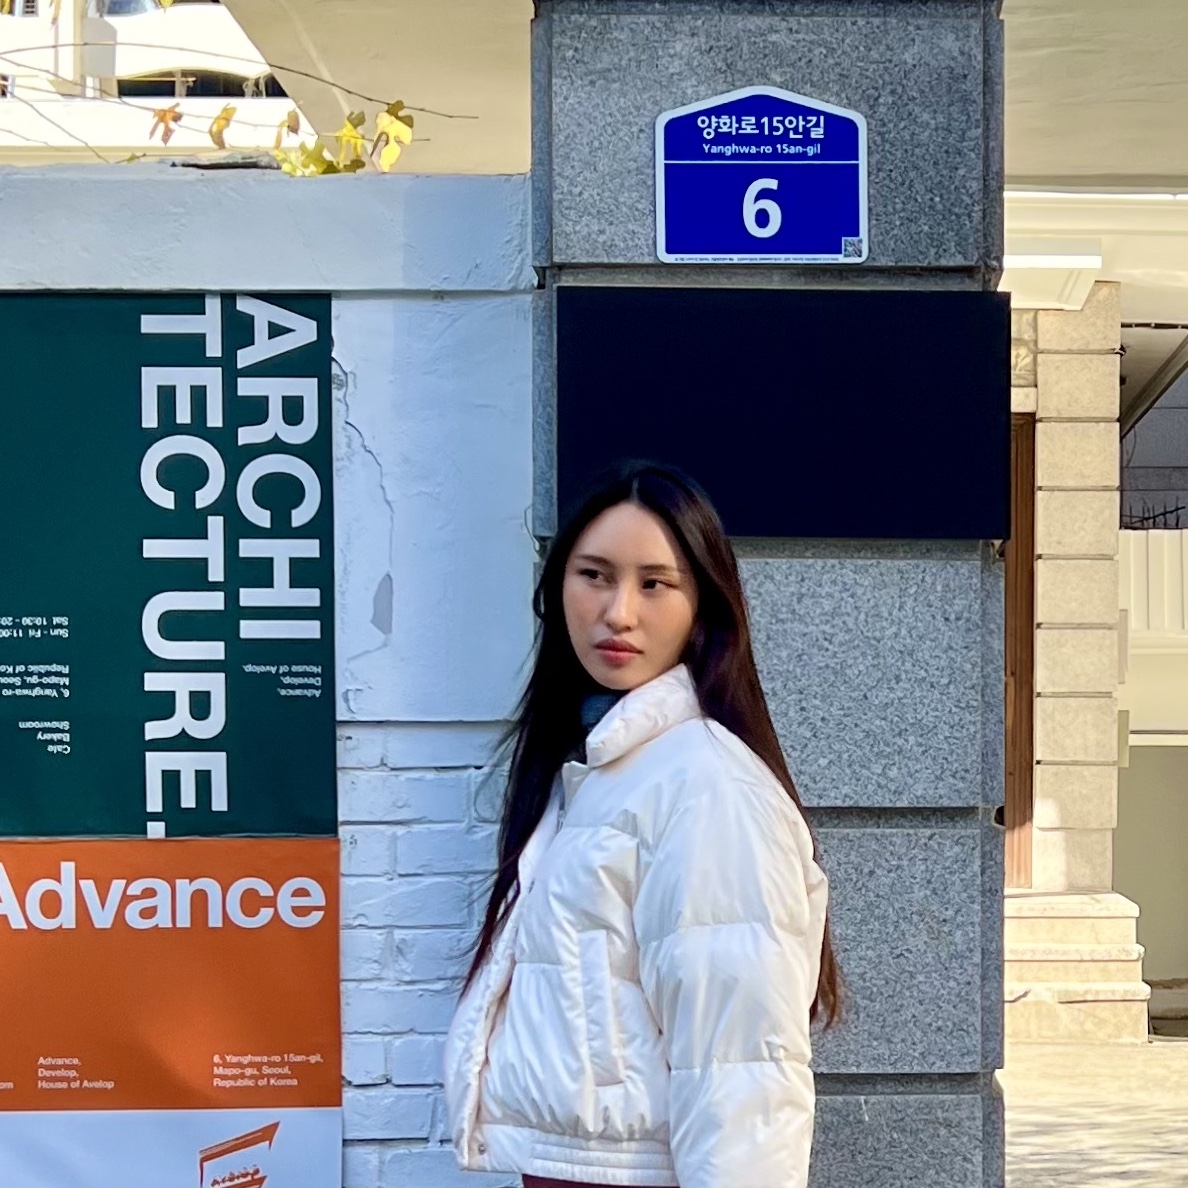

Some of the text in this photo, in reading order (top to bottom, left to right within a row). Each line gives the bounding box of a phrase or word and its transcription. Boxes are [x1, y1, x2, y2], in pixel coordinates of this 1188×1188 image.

[697, 115, 824, 140] 양화로15안길
[702, 143, 821, 156] Yanghwa-ro 15an-gil
[742, 177, 782, 239] 6
[236, 293, 323, 638] ARCHI
[140, 293, 229, 838] TECTURE.
[22, 617, 47, 626] 10:30
[52, 617, 69, 626] Sat
[29, 629, 41, 638] Fri
[50, 629, 69, 638] Sun
[15, 665, 25, 673] of
[27, 663, 69, 673] Republic
[279, 665, 289, 674] of
[291, 665, 321, 674] House
[2, 687, 58, 697] Yanghwa-ro
[18, 721, 70, 730] Showroom
[37, 731, 70, 742] Bakery
[47, 744, 70, 754] Cafe
[38, 1056, 81, 1065] Advance,
[225, 1054, 281, 1064] Yanghwa-ro
[38, 1068, 79, 1078] Develop,
[262, 1065, 291, 1074] Seoul,
[38, 1080, 115, 1089] House of Avelop
[213, 1077, 298, 1088] Republic of Korea
